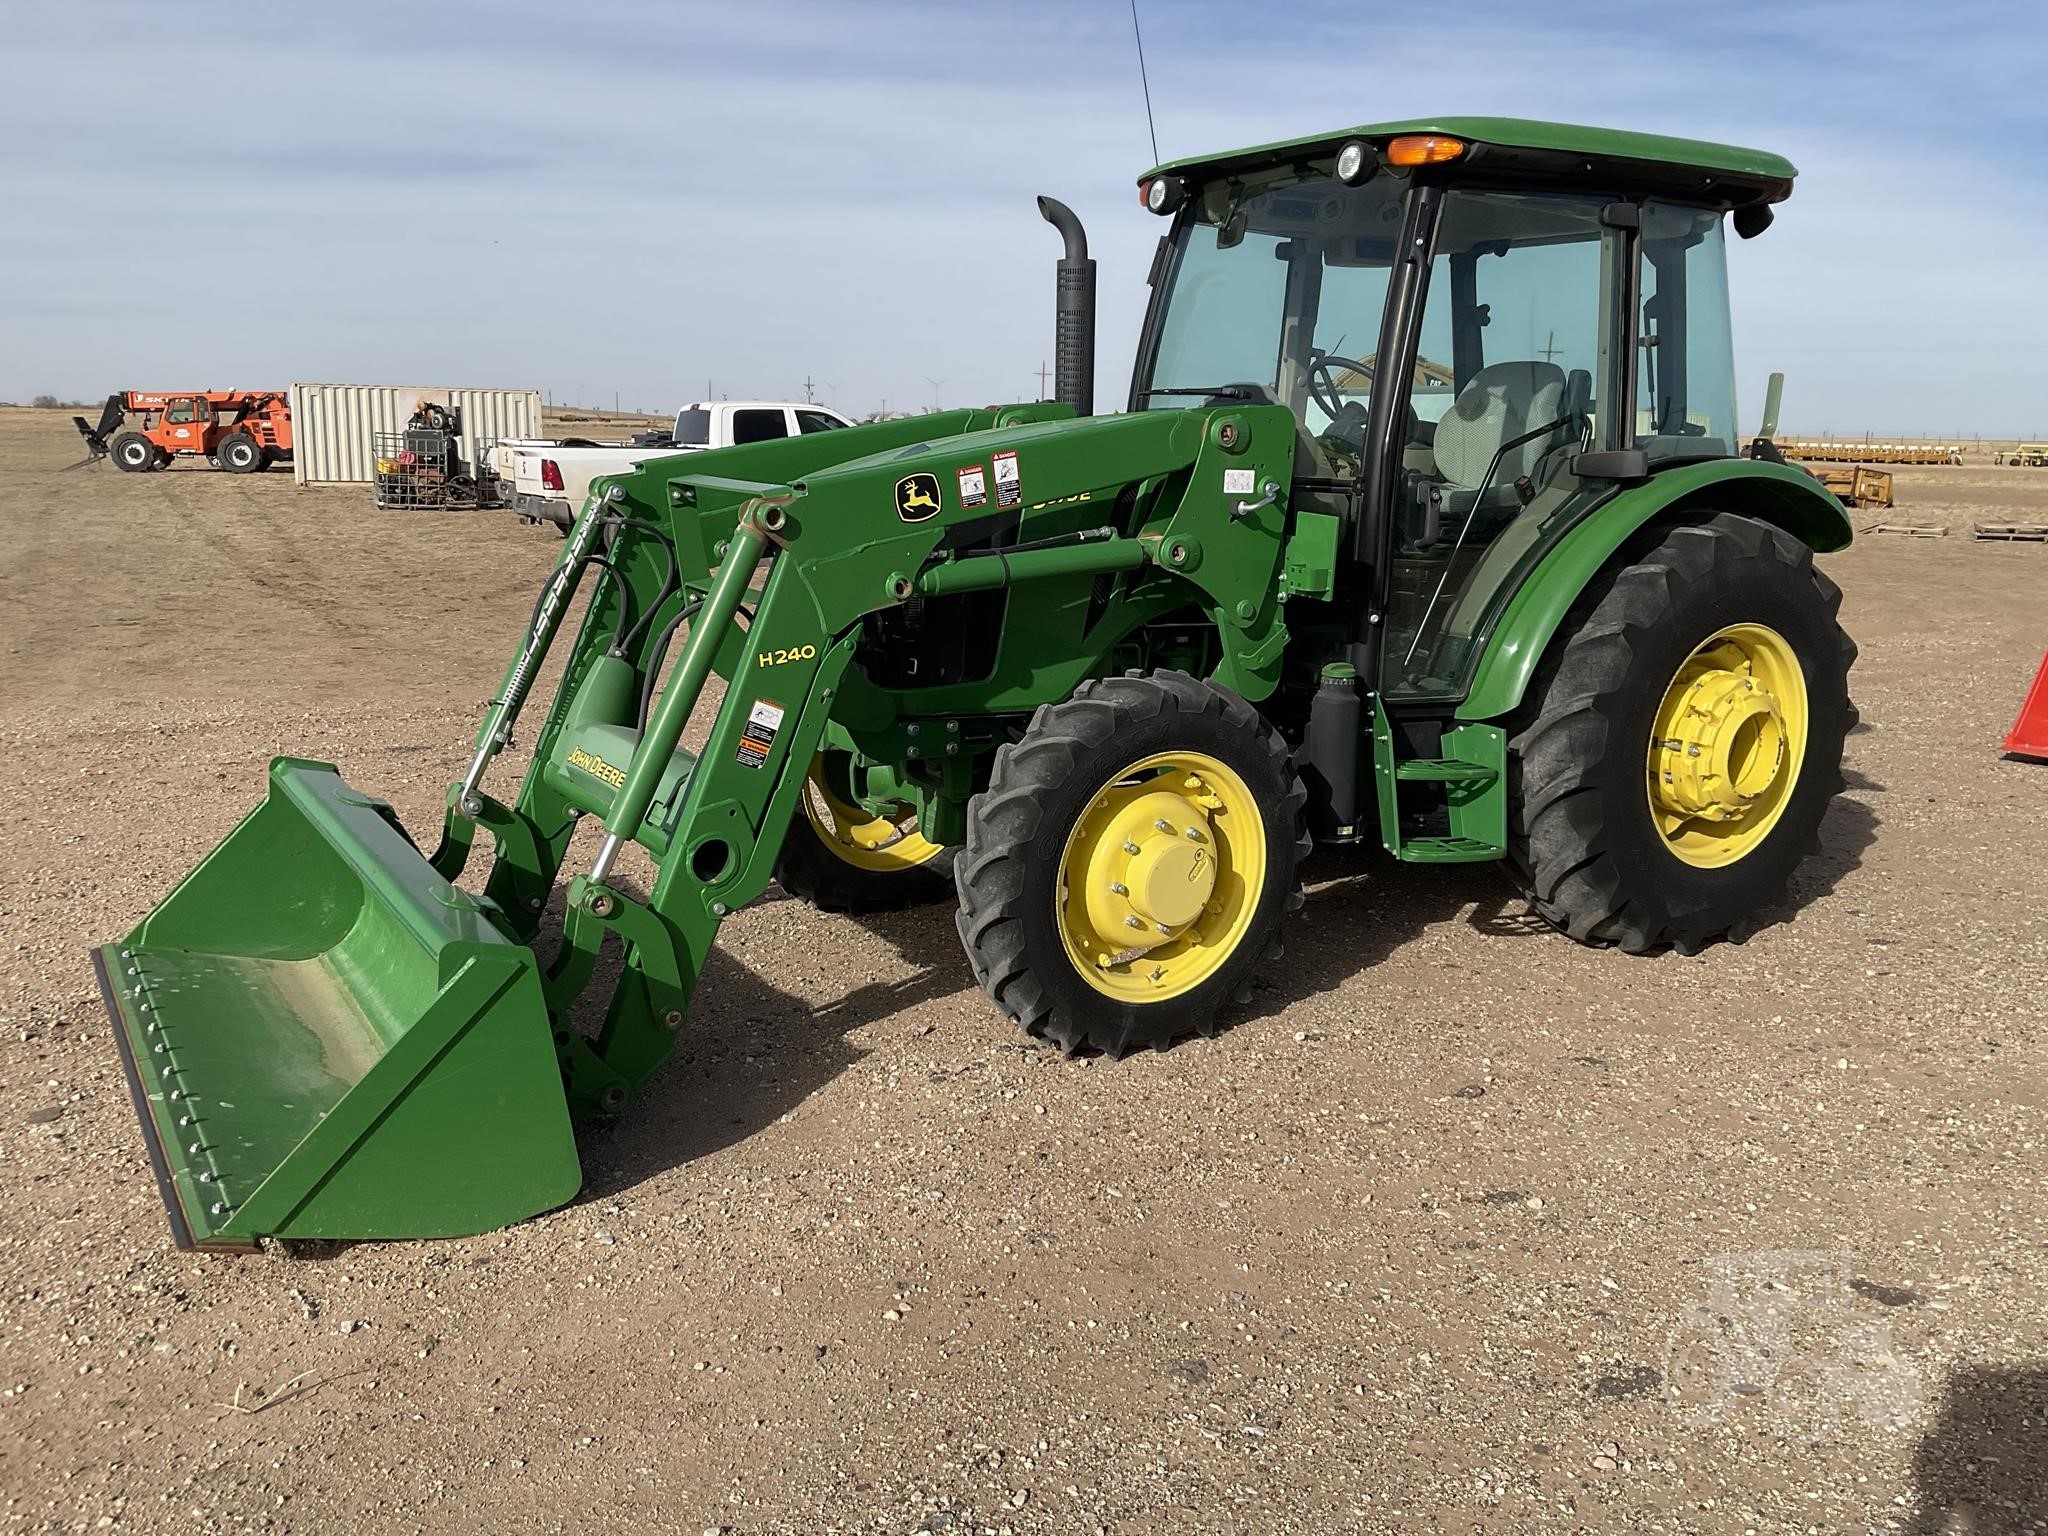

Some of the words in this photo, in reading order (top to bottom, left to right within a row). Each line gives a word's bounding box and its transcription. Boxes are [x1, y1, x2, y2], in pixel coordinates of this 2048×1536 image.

[1430, 379, 1442, 387] CAT
[758, 644, 816, 668] H240
[567, 745, 593, 771] JOHN
[589, 755, 627, 788] DEERE
